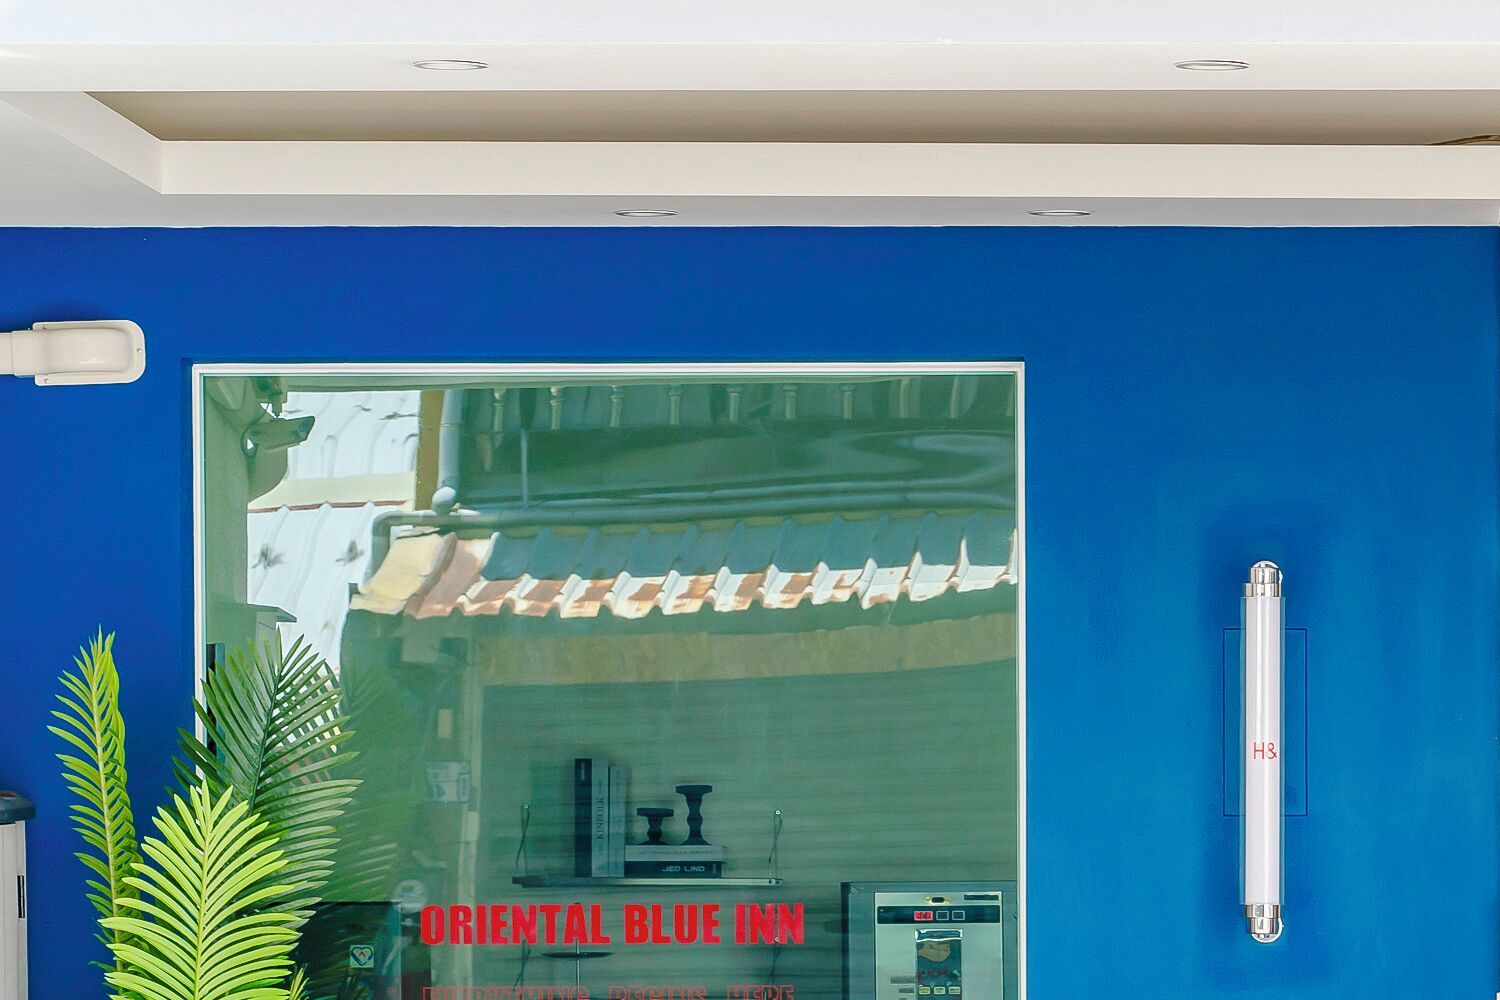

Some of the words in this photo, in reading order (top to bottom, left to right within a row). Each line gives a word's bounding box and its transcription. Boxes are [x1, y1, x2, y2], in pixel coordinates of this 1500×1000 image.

[597, 796, 605, 840] KINFOLK
[662, 865, 681, 873] JED
[684, 865, 706, 873] LIND
[421, 904, 611, 945] ORIENTAL
[623, 904, 721, 945] BLUE
[735, 904, 804, 945] INN
